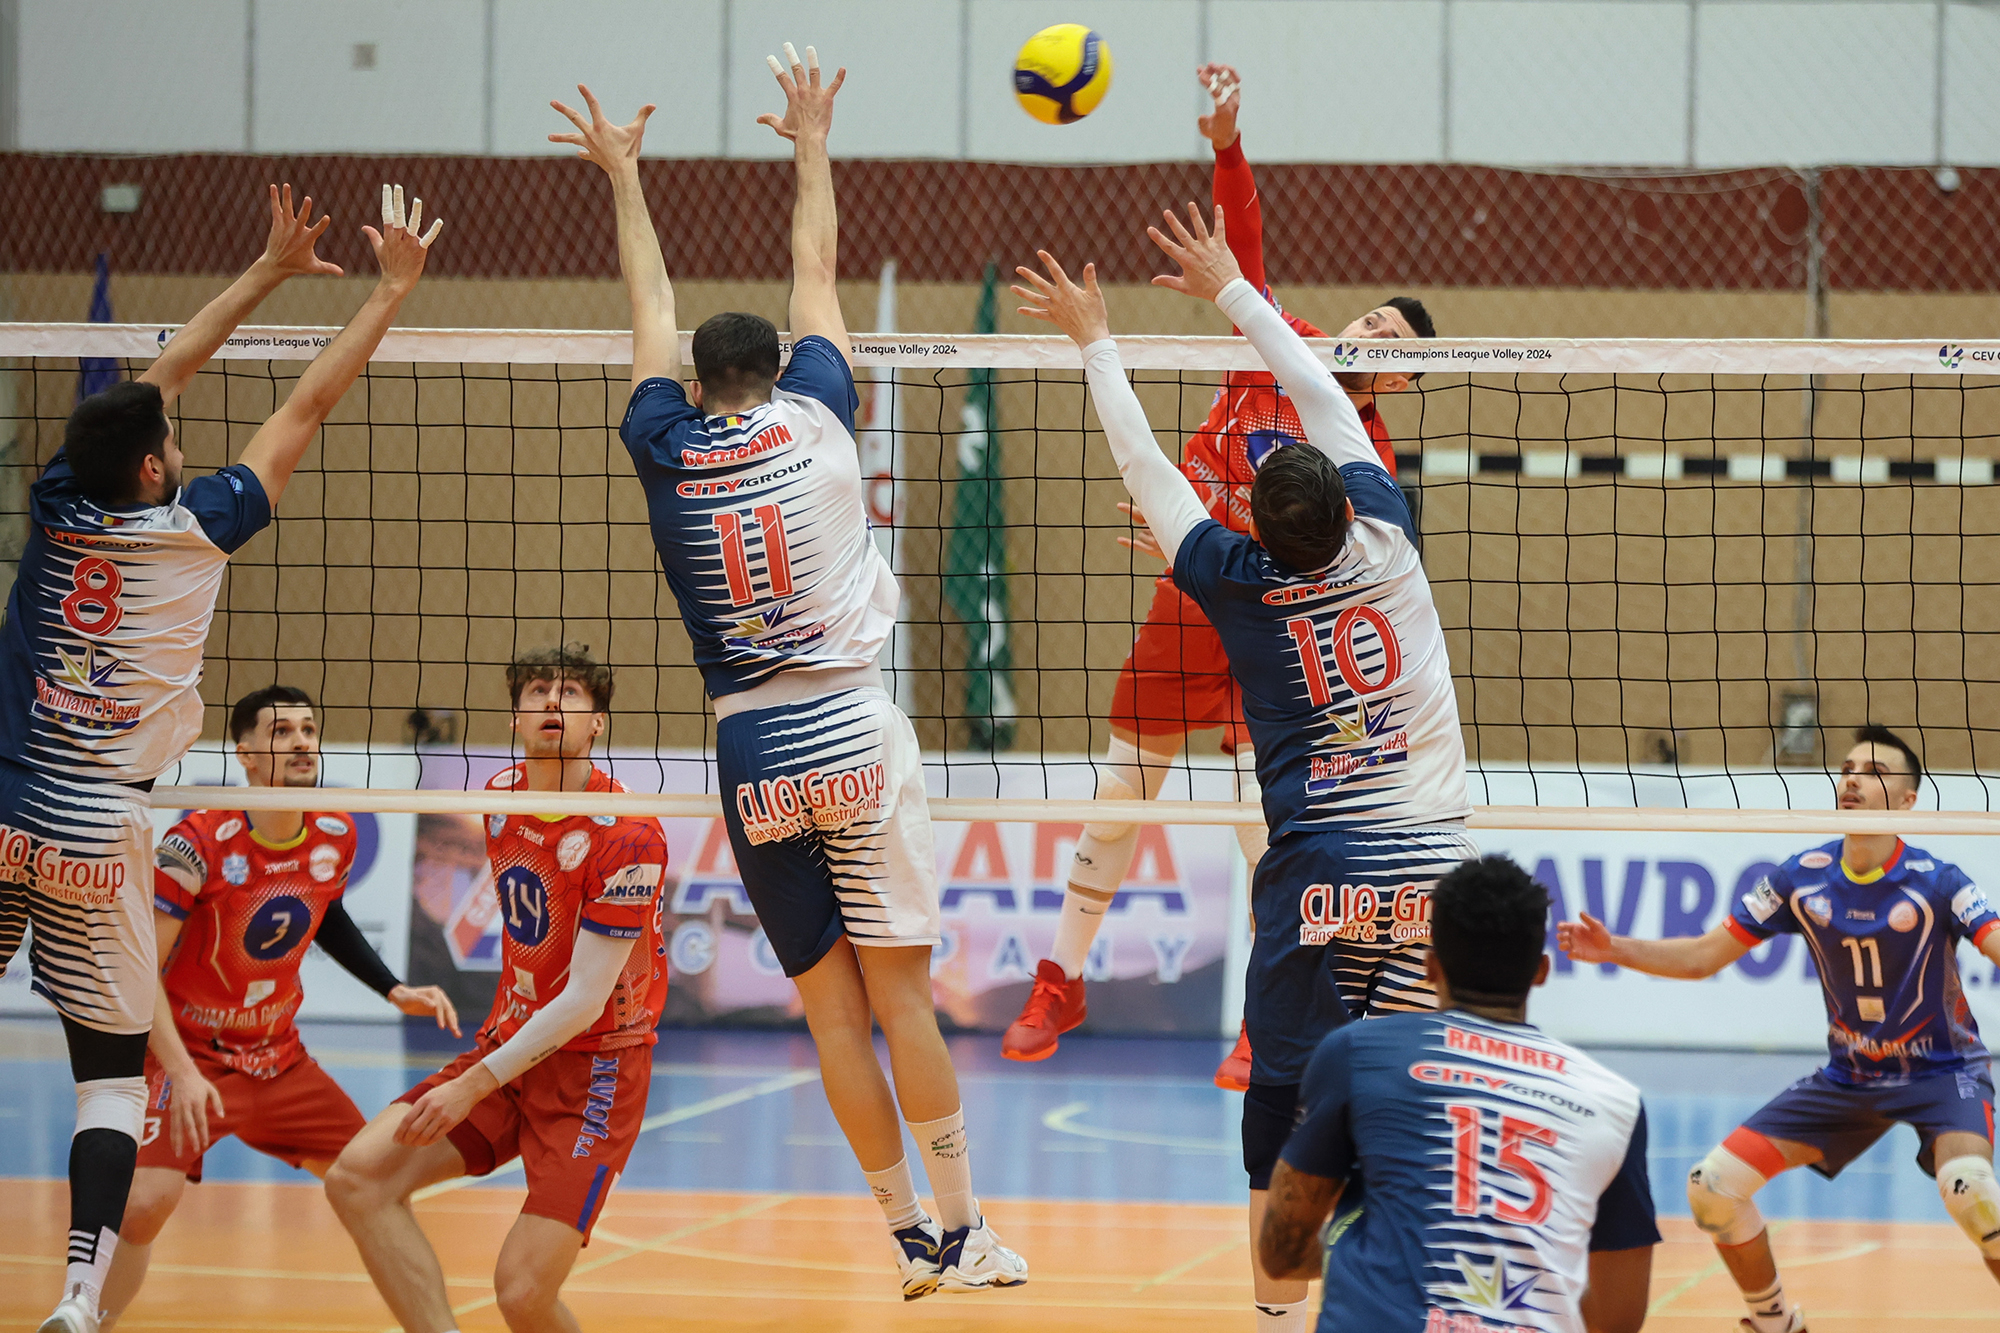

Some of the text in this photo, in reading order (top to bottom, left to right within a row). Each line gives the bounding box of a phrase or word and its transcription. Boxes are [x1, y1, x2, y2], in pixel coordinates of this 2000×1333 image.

[273, 337, 310, 348] League
[312, 337, 331, 347] Voll
[859, 344, 896, 356] League
[899, 344, 930, 356] Volley
[932, 344, 957, 354] 2024
[1367, 349, 1552, 362] CEV Champions League Volley 2024
[1972, 351, 1995, 361] CEV
[713, 503, 794, 607] 11
[60, 556, 124, 637] 8
[1286, 604, 1401, 708] 10
[35, 677, 141, 721] Brilliant Plaza
[737, 762, 885, 826] CLIO Group
[37, 846, 125, 903] Group
[38, 879, 109, 905] Construction
[506, 876, 542, 939] 14
[1303, 886, 1377, 925] CLIO
[260, 911, 292, 950] 3
[1363, 925, 1375, 939] &
[1841, 936, 1883, 988] 11
[1446, 1026, 1568, 1076] RAMIREZ
[1446, 1104, 1558, 1225] 15
